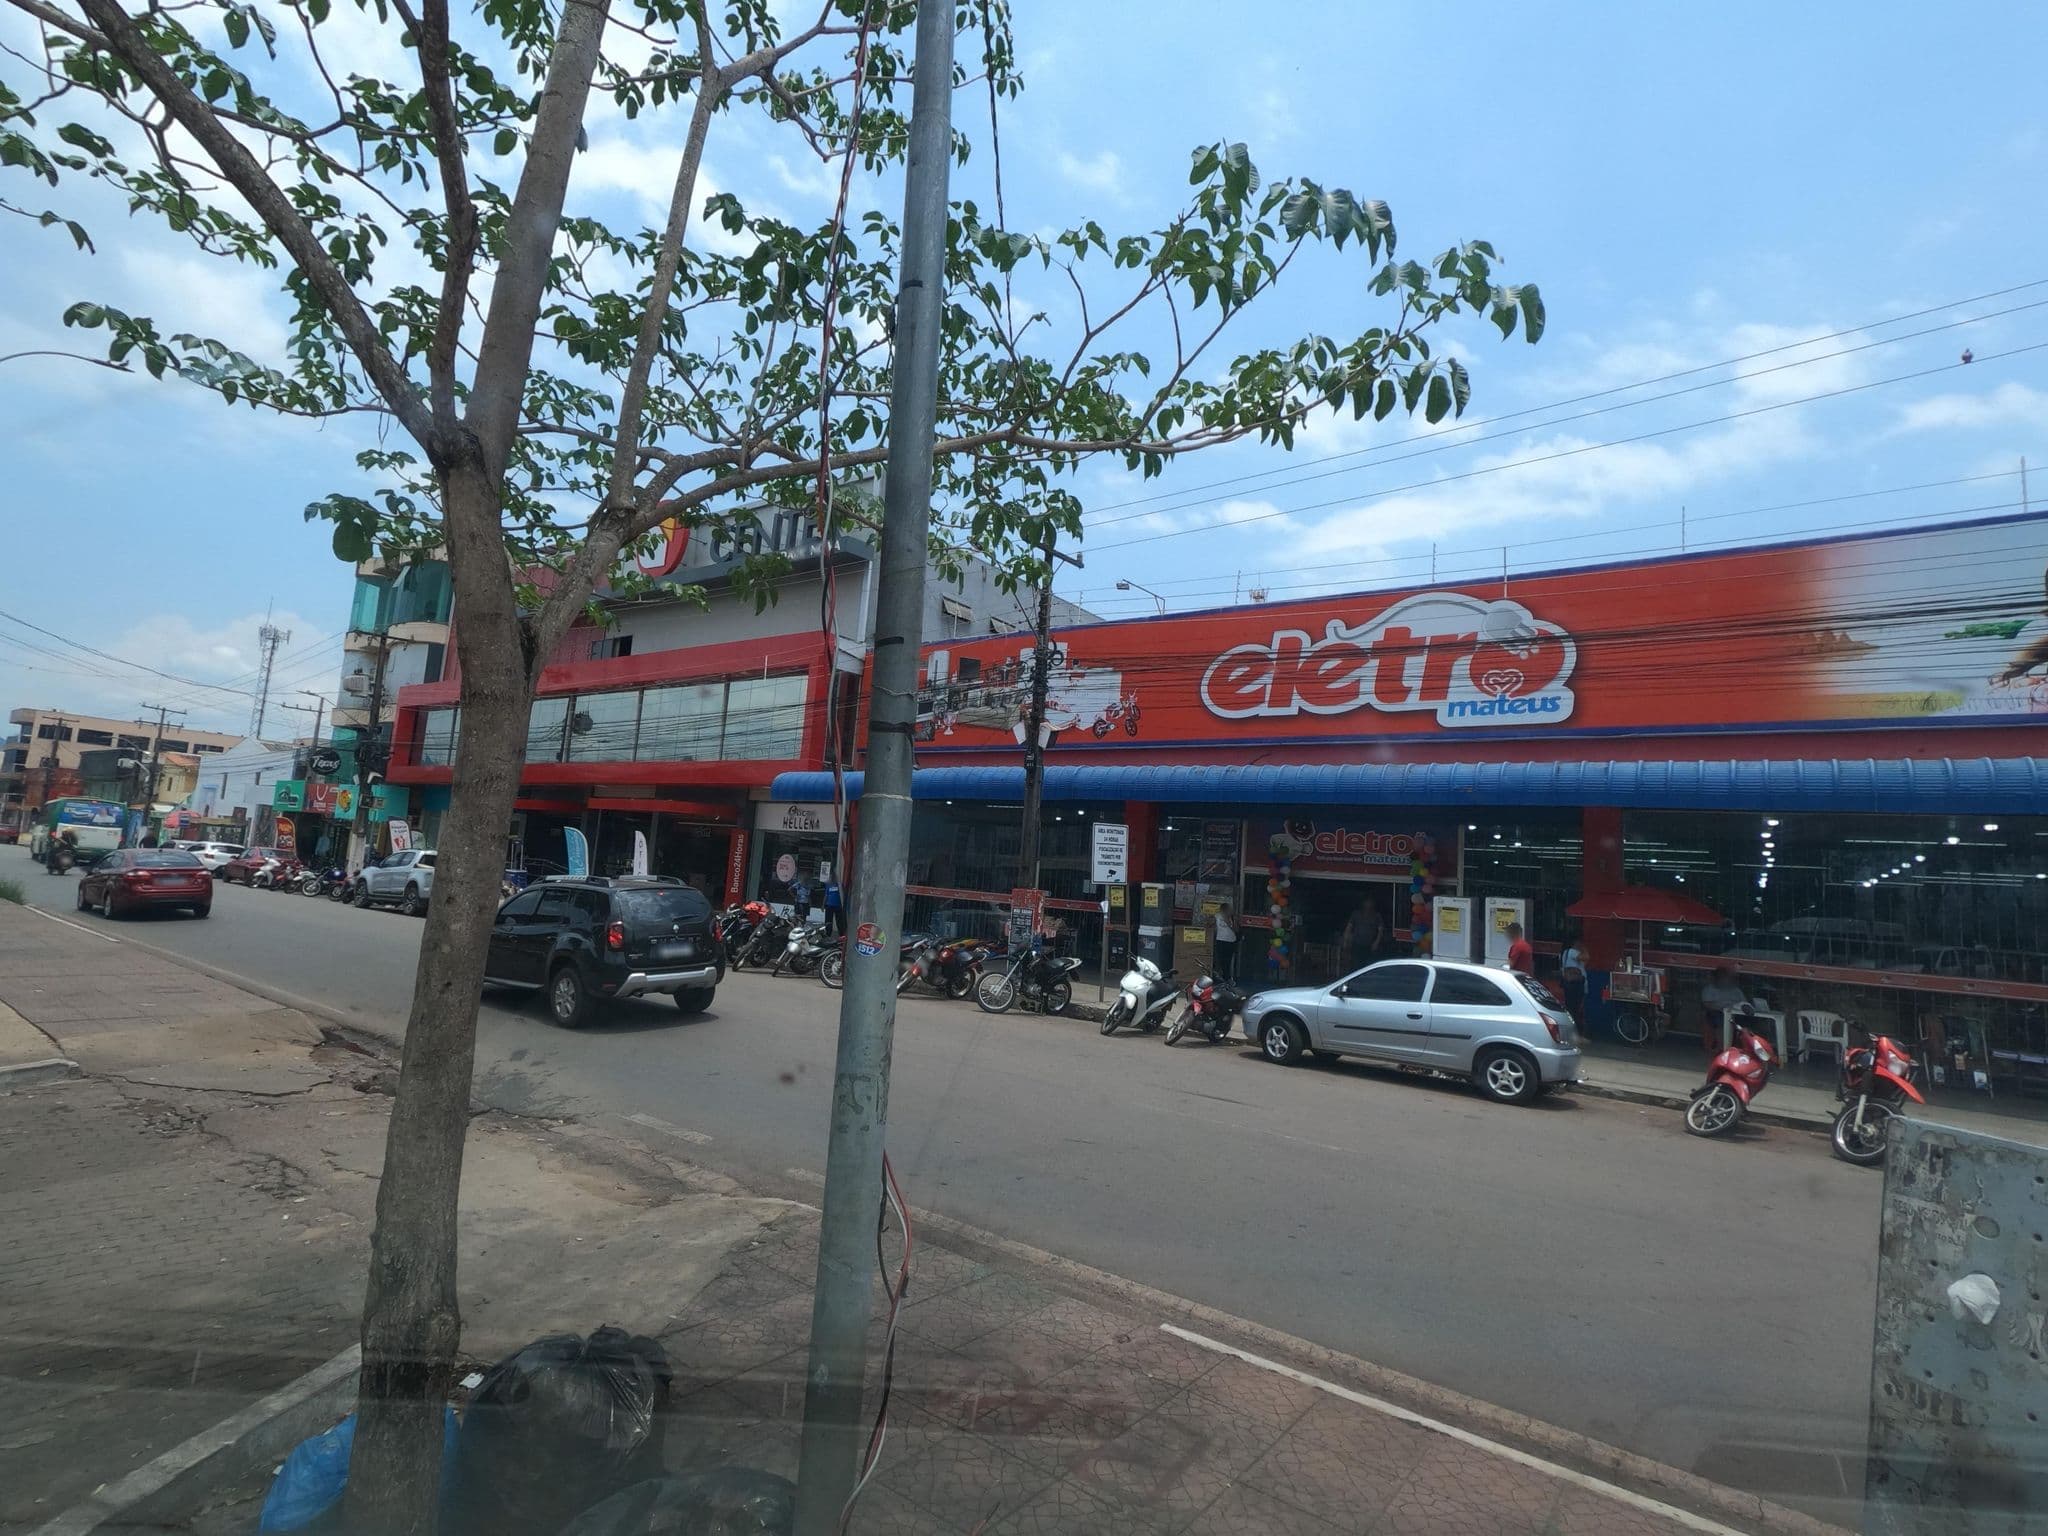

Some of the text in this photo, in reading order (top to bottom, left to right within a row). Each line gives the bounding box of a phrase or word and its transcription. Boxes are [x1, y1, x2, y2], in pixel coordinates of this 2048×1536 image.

[1204, 627, 1570, 716] eletro
[1447, 694, 1562, 718] mateus
[1314, 828, 1415, 856] eletro
[731, 834, 744, 893] Banco24Horas
[1365, 856, 1412, 865] mateus
